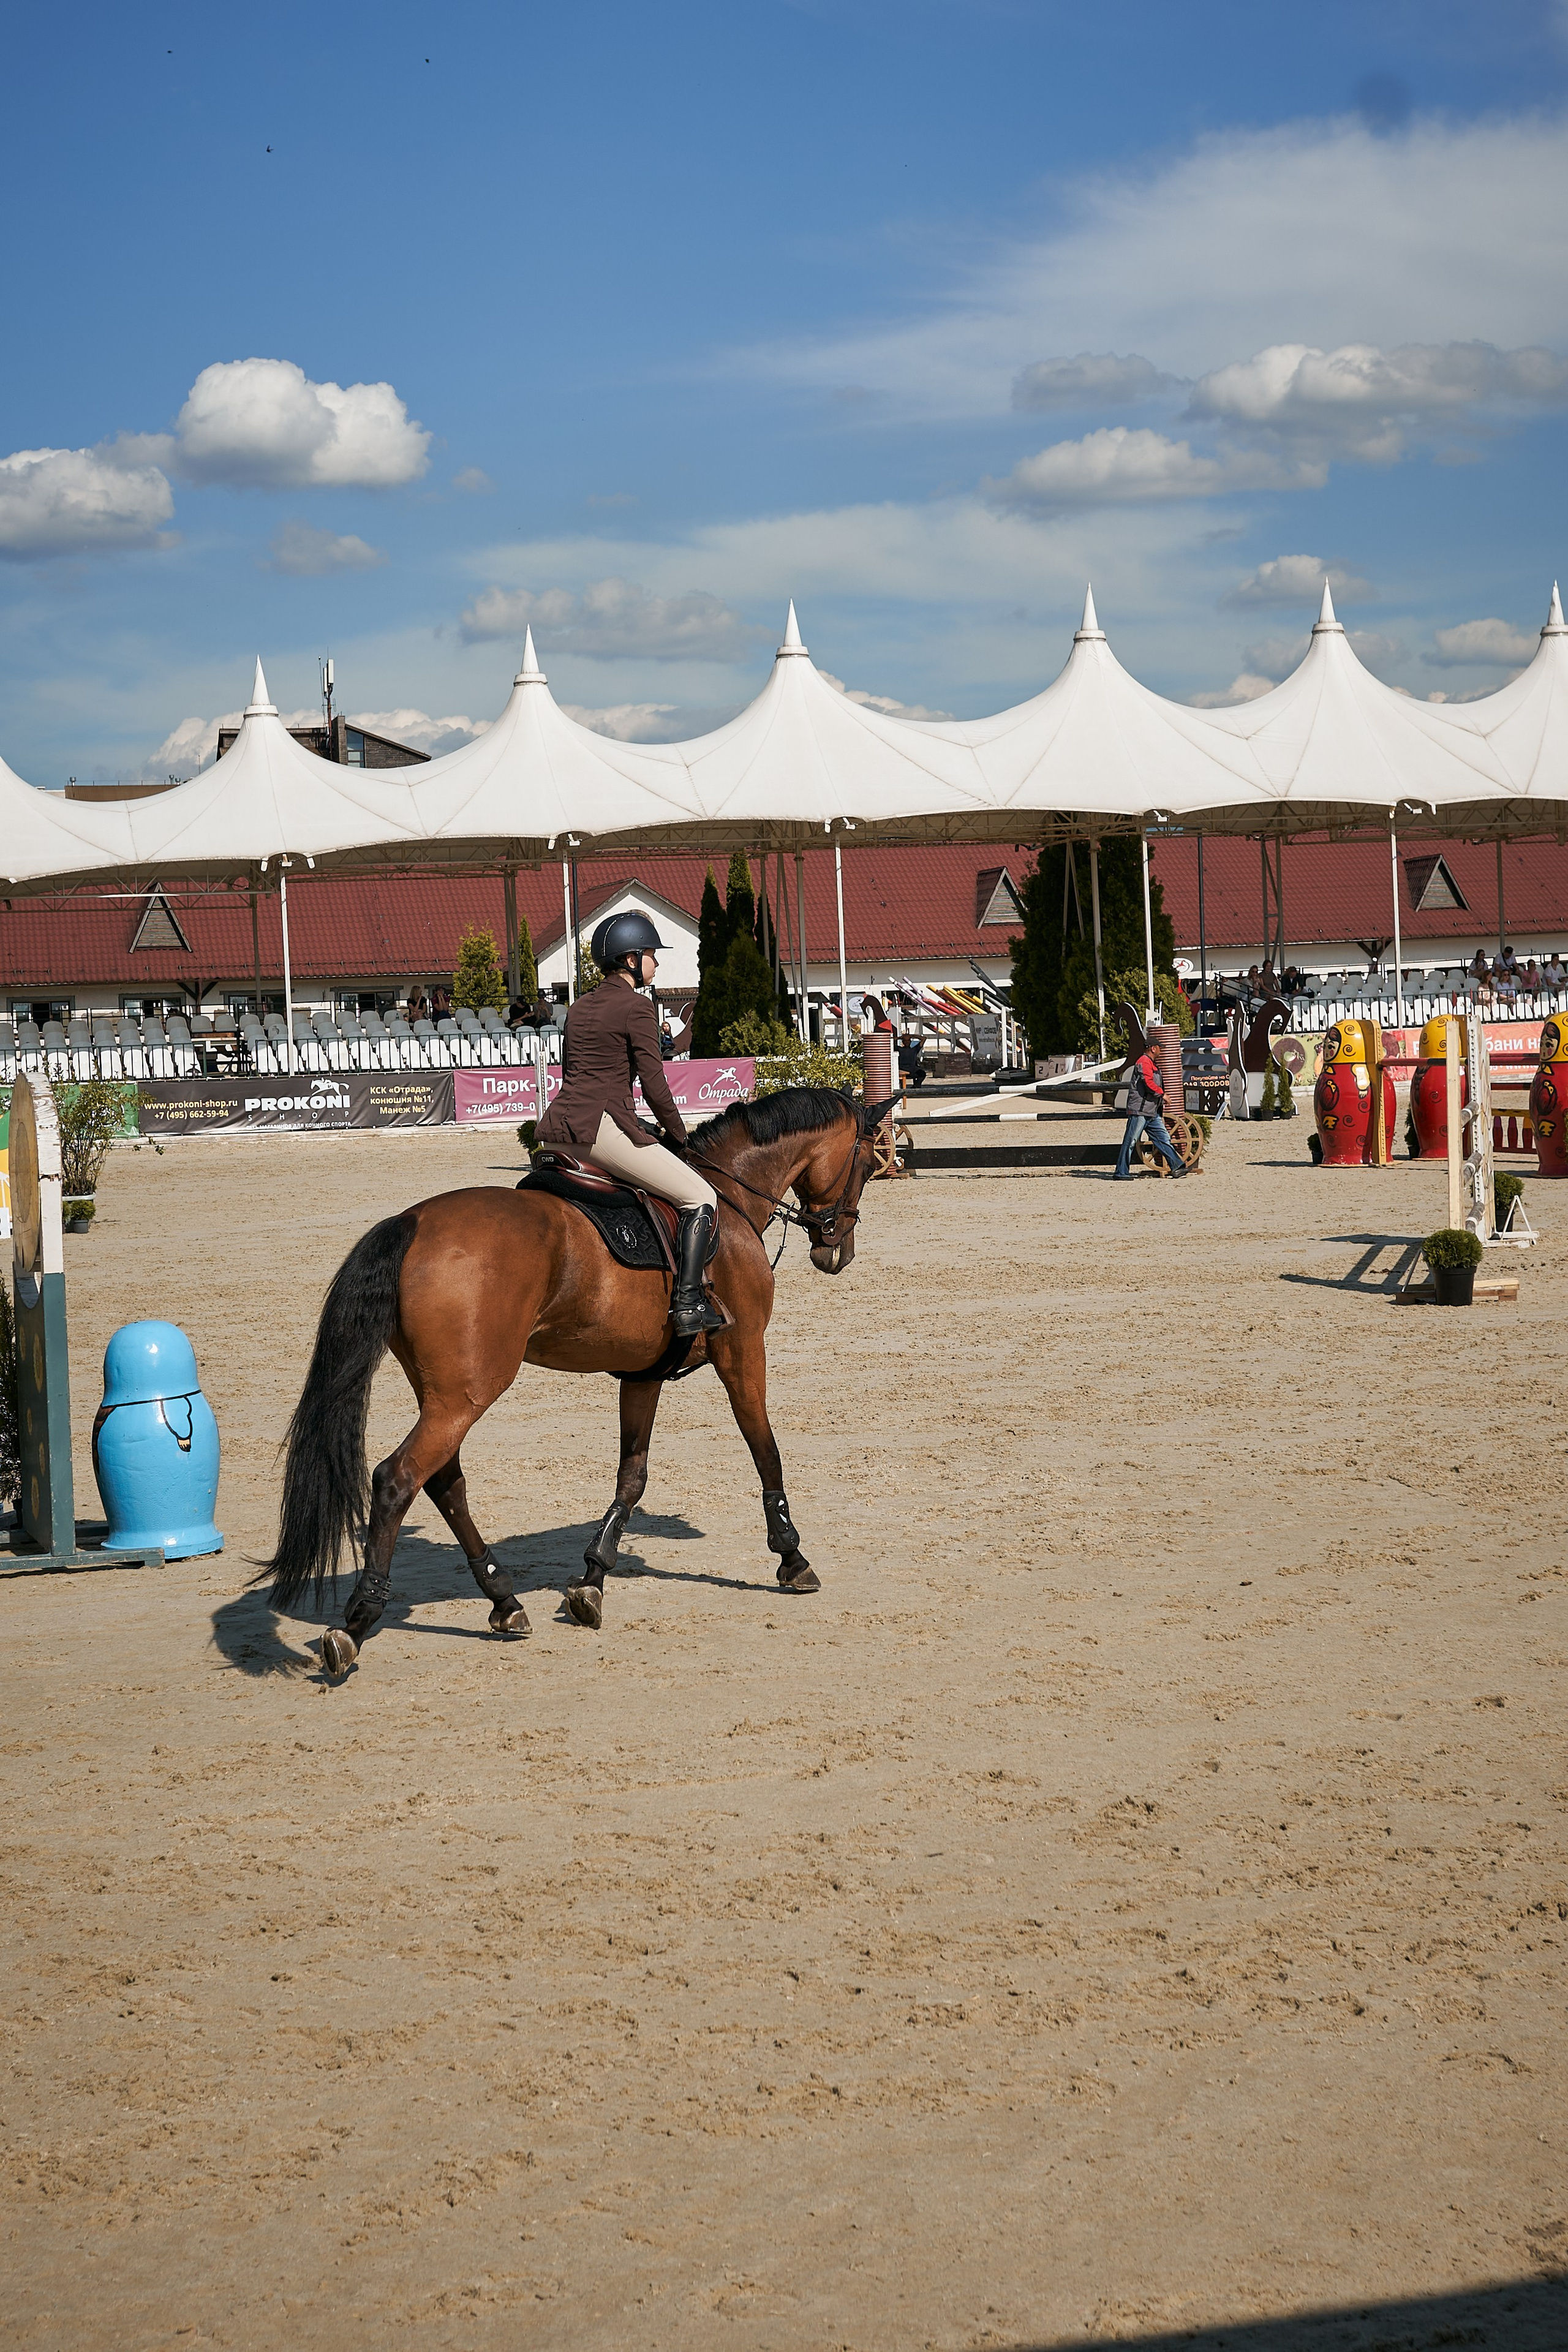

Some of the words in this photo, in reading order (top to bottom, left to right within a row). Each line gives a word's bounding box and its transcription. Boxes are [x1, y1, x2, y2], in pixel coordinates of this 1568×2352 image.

[389, 1086, 434, 1095] «Отрада»,
[698, 1080, 749, 1104] Отрада
[145, 1099, 238, 1110] www.prokoni-shop.ru
[244, 1095, 351, 1112] PROKONI
[166, 1110, 187, 1120] (495)
[189, 1109, 229, 1118] 662-59-94
[466, 1104, 503, 1115] +7(495)
